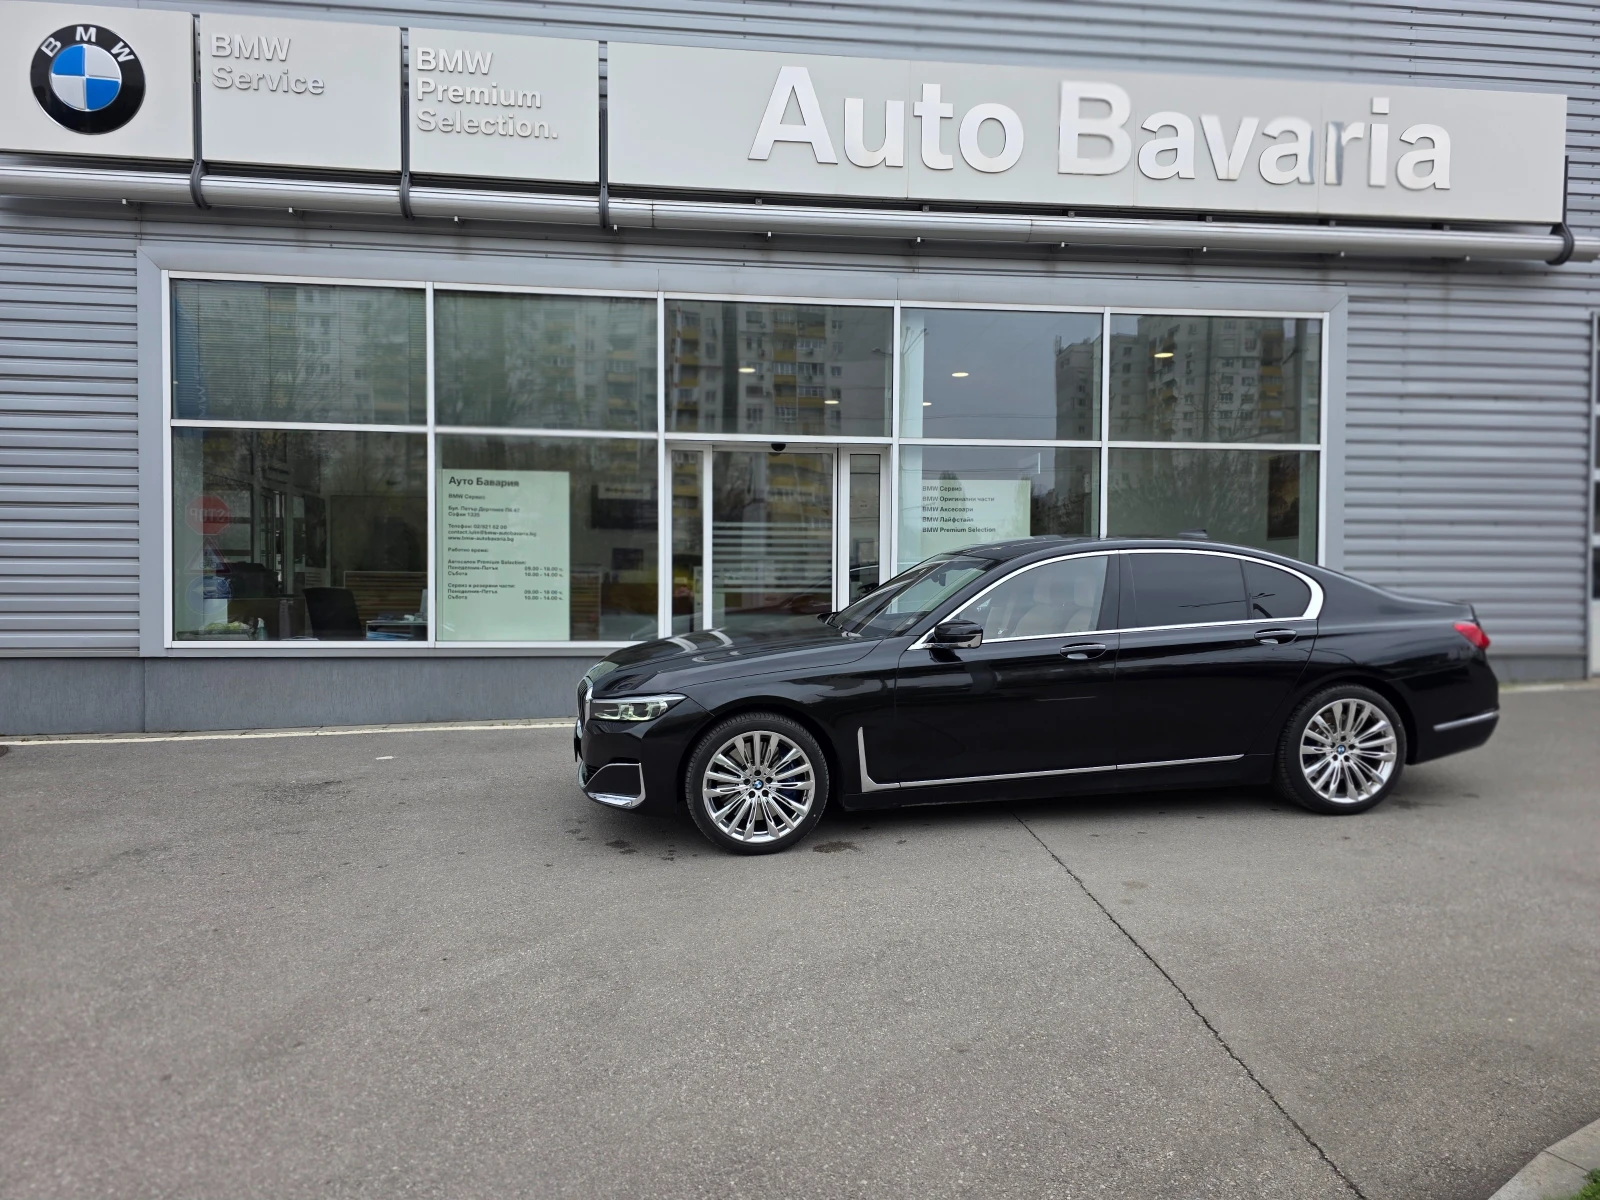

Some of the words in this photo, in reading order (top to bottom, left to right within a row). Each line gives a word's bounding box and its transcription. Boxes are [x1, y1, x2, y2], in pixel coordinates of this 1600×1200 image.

[40, 26, 135, 62] BMW
[211, 33, 291, 61] BMW
[416, 47, 493, 75] BMW
[212, 66, 325, 95] Service
[416, 77, 541, 108] Premium
[416, 108, 559, 139] Selection.
[748, 66, 1024, 173] Auto
[1058, 80, 1451, 191] Bavaria
[448, 476, 474, 486] Ауто
[476, 477, 520, 488] Бавария
